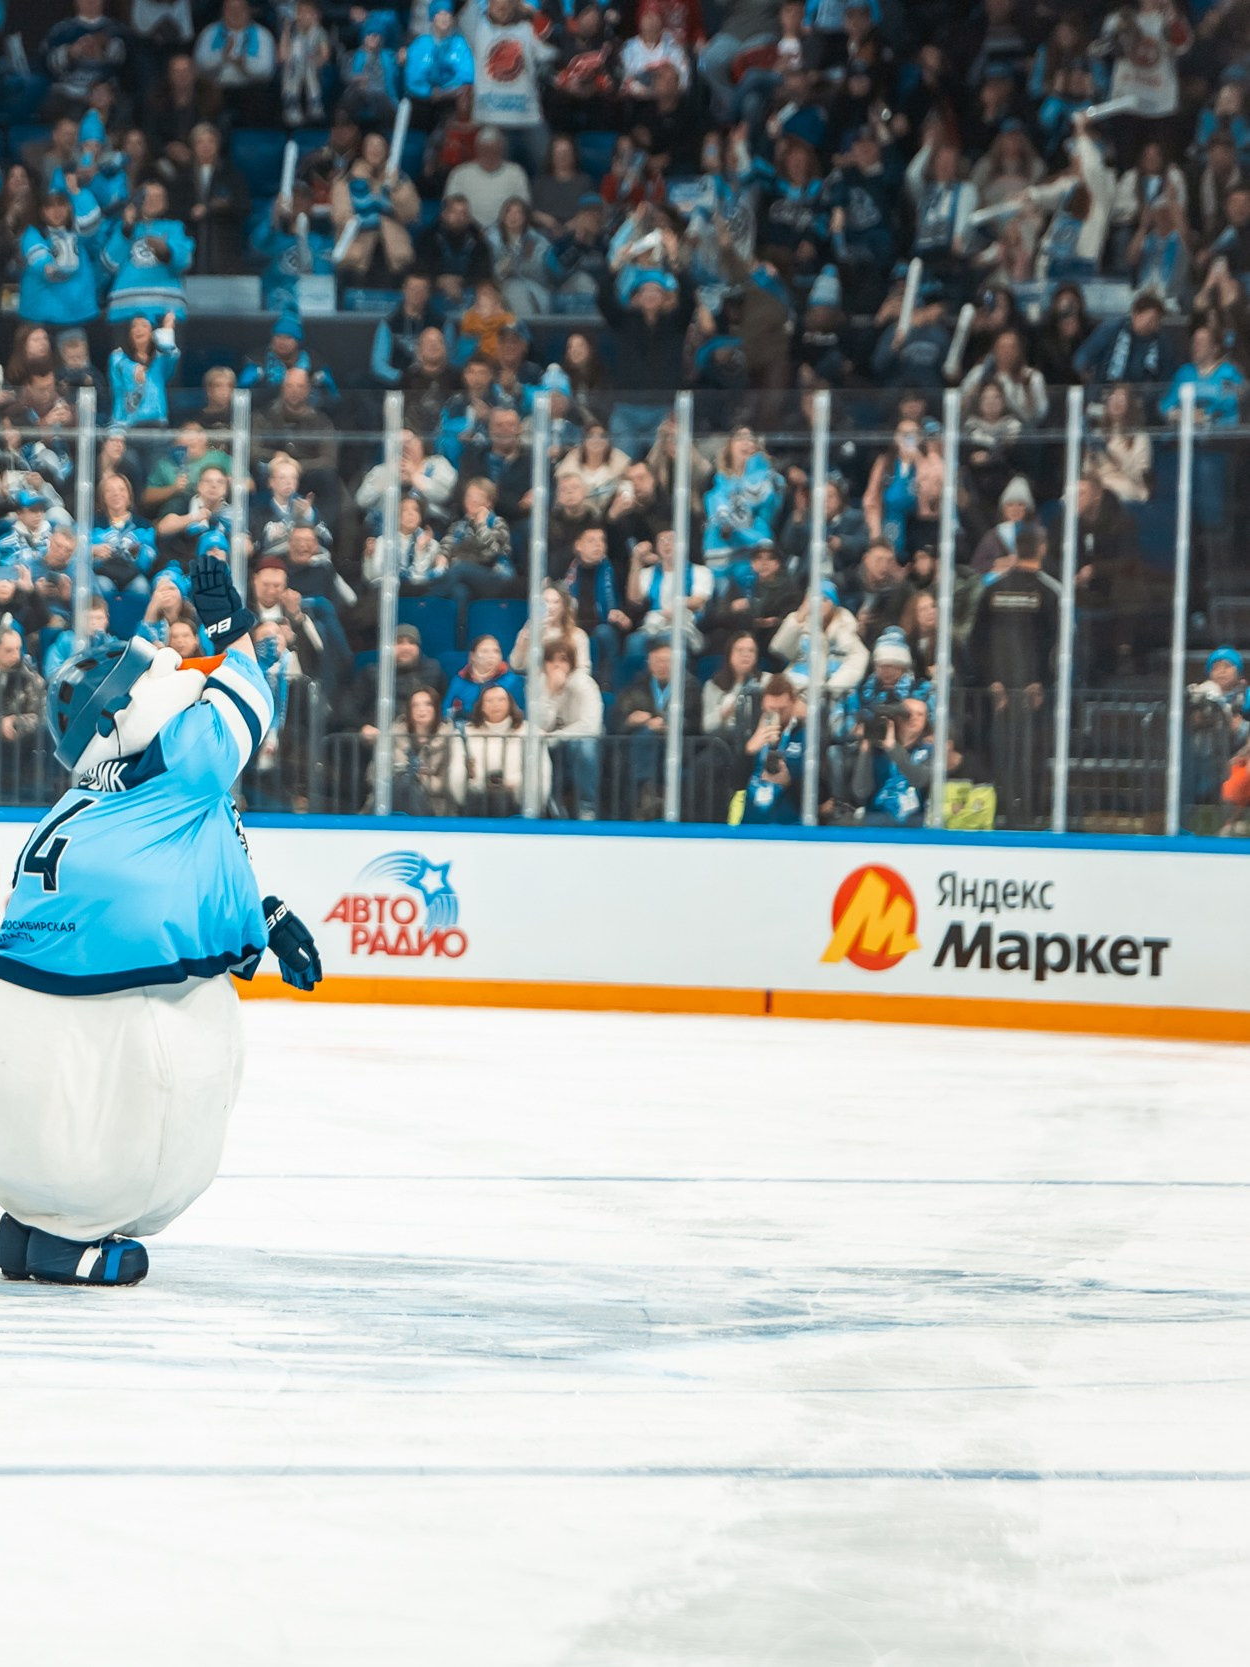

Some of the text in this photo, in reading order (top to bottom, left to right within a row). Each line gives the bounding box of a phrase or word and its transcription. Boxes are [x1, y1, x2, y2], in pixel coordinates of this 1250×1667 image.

[322, 893, 417, 925] АВТО
[937, 871, 1055, 913] Яндекс
[351, 926, 468, 958] РАДИО
[933, 920, 1172, 981] Маркет
